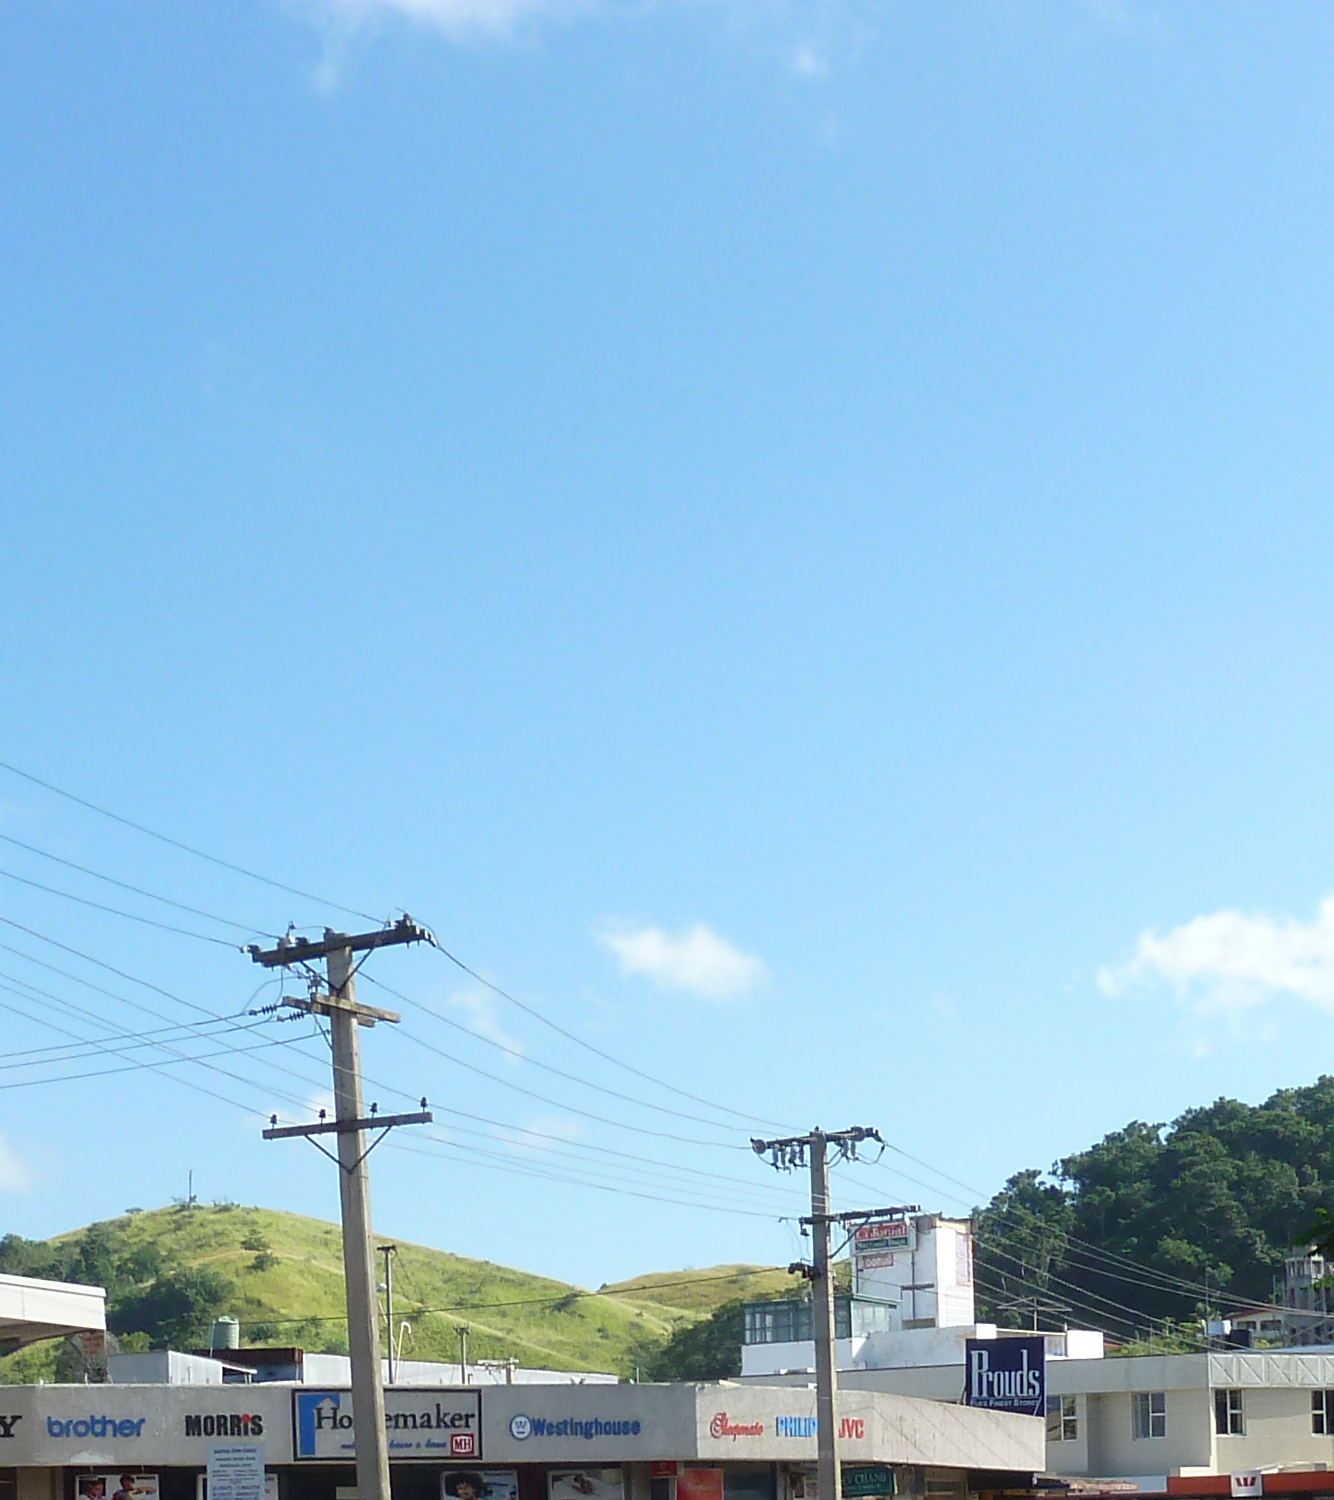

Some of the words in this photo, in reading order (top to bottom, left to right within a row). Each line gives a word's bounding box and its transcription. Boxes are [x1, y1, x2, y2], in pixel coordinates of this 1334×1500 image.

[971, 1349, 1040, 1398] Prouds
[47, 1414, 147, 1438] brother
[315, 1403, 475, 1429] Hoemaker
[775, 1416, 818, 1438] PHILIP
[531, 1417, 641, 1440] Westinghouse
[838, 1418, 865, 1439] JVC
